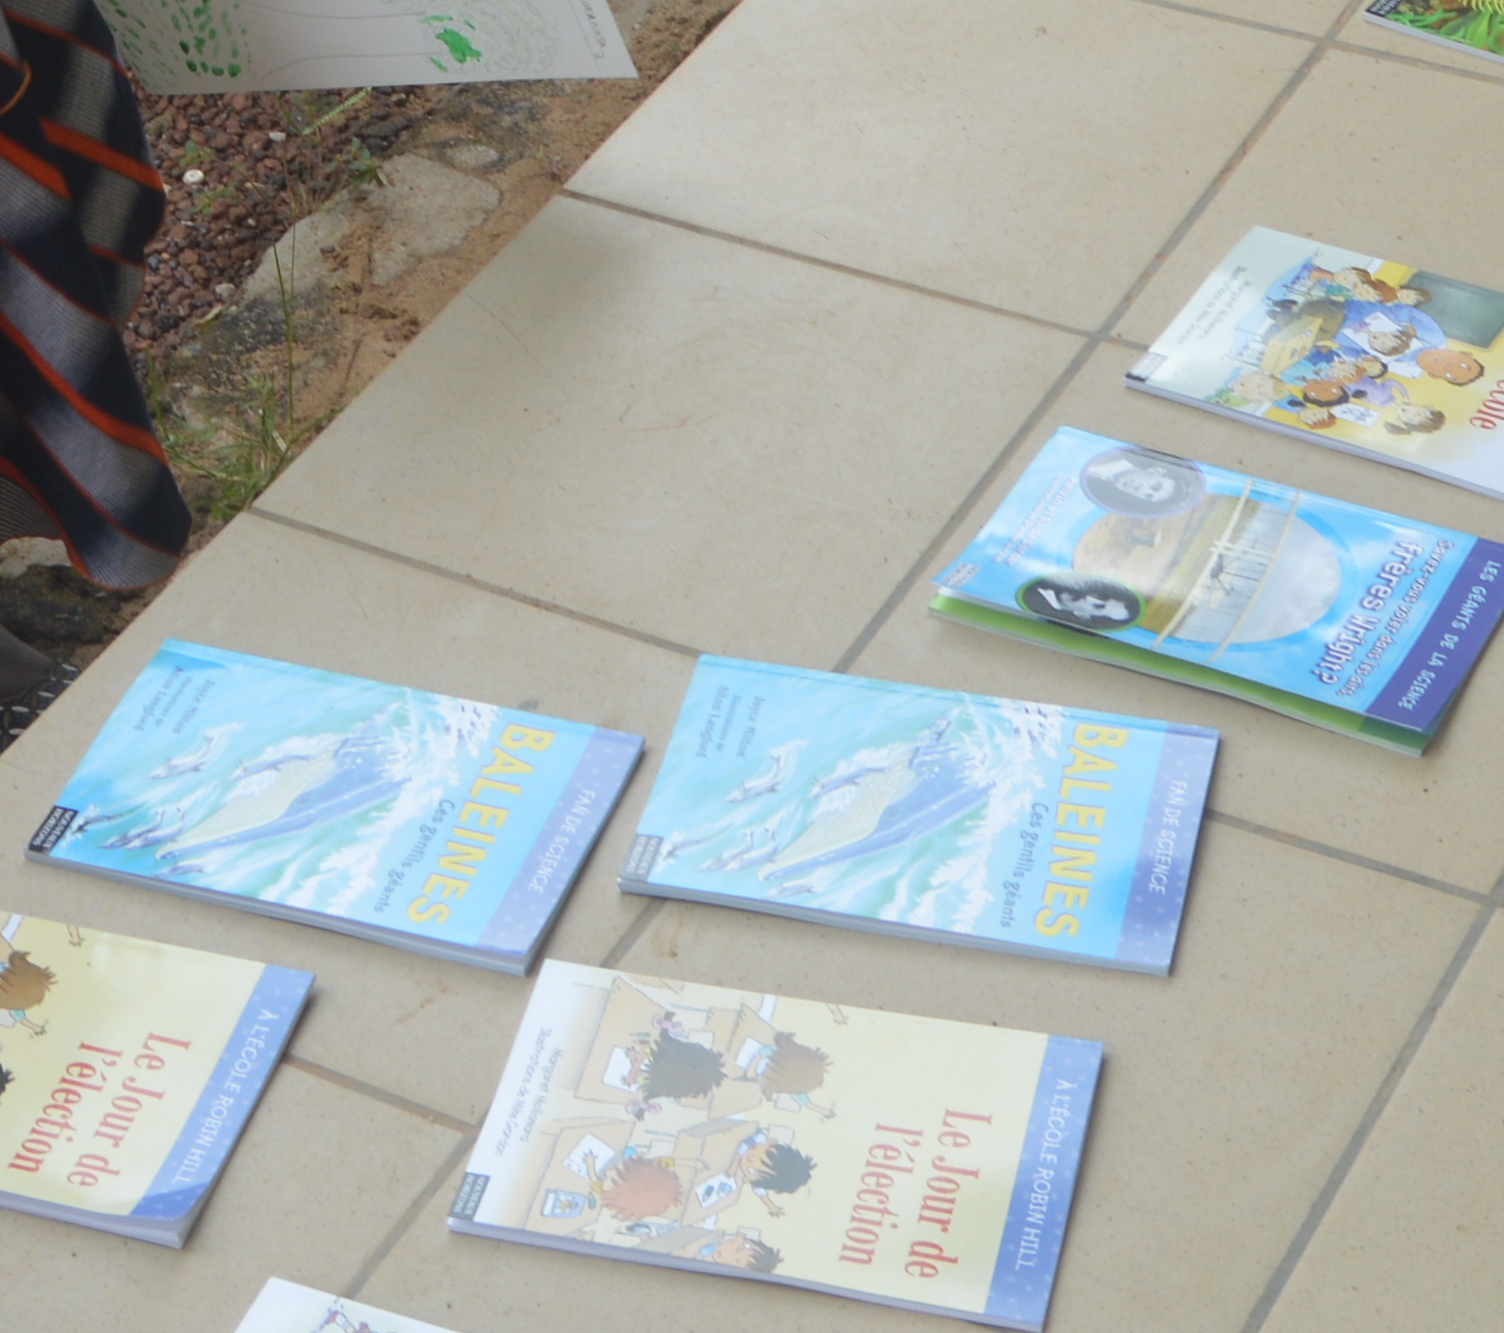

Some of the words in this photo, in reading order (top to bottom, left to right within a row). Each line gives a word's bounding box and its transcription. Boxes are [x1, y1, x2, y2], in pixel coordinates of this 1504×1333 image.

[1479, 560, 1501, 582] LES
[1451, 586, 1487, 630] GÉANTS
[1427, 652, 1446, 666] LA
[1440, 633, 1459, 649] DE
[1398, 669, 1435, 709] SCIENCE
[407, 725, 555, 924] BALEINES
[1035, 724, 1129, 937] BALEINES
[258, 1009, 280, 1020] À
[134, 1032, 191, 1070] Le
[224, 1024, 270, 1093] L'ÉCOLE
[1056, 1079, 1076, 1090] À
[94, 1076, 164, 1148] Jour
[195, 1094, 234, 1146] ROBIN
[938, 1109, 992, 1148] Le
[1040, 1095, 1071, 1164] L'ÉCOLE
[67, 1153, 120, 1187] de
[170, 1148, 206, 1188] HILL
[918, 1156, 980, 1233] Jour
[1025, 1167, 1054, 1224] ROBIN
[905, 1241, 959, 1278] de
[1015, 1227, 1040, 1270] HILL
